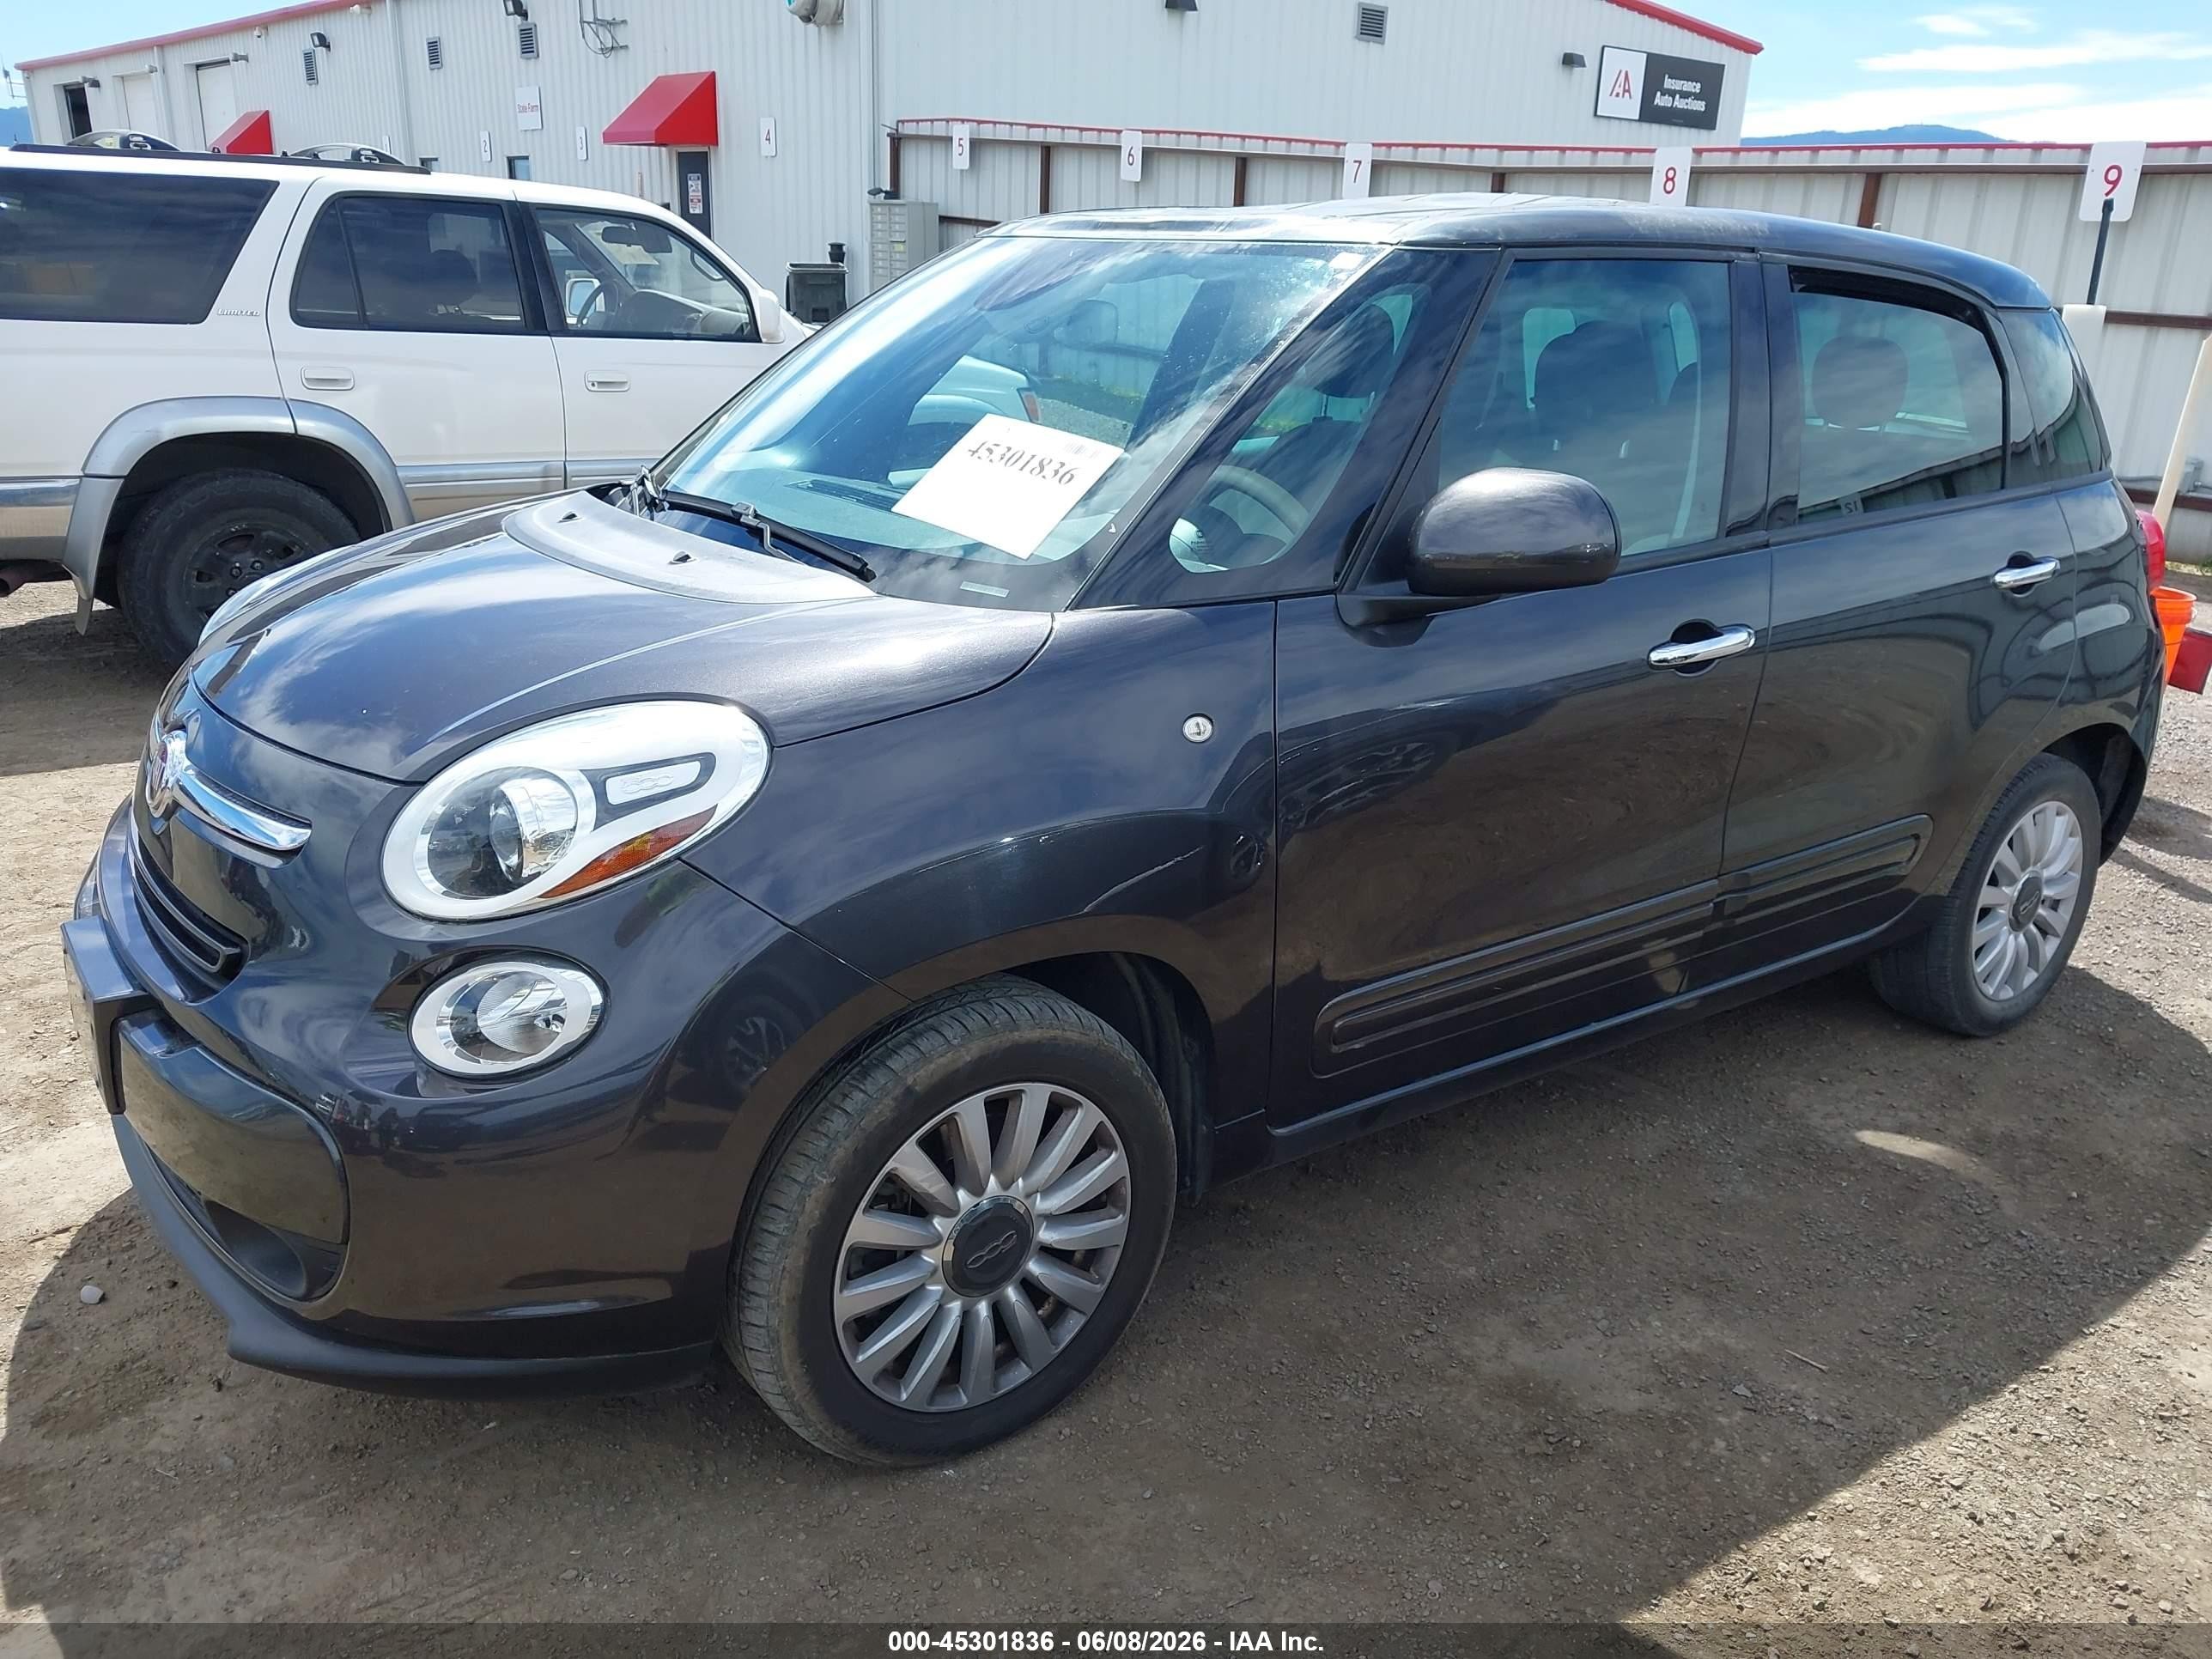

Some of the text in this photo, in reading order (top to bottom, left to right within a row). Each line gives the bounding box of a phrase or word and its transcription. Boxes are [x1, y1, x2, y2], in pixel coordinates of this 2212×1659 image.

[1663, 74, 1701, 94] Insurance
[1654, 91, 1706, 112] Auto Auctions
[765, 128, 772, 145] 4
[957, 137, 964, 156] 5
[1127, 145, 1135, 167] 6
[1352, 160, 1361, 184] 7
[1662, 167, 1676, 194] 8
[2104, 164, 2123, 197] 9
[217, 308, 260, 317] LIMITED
[968, 441, 1079, 486] 45301836
